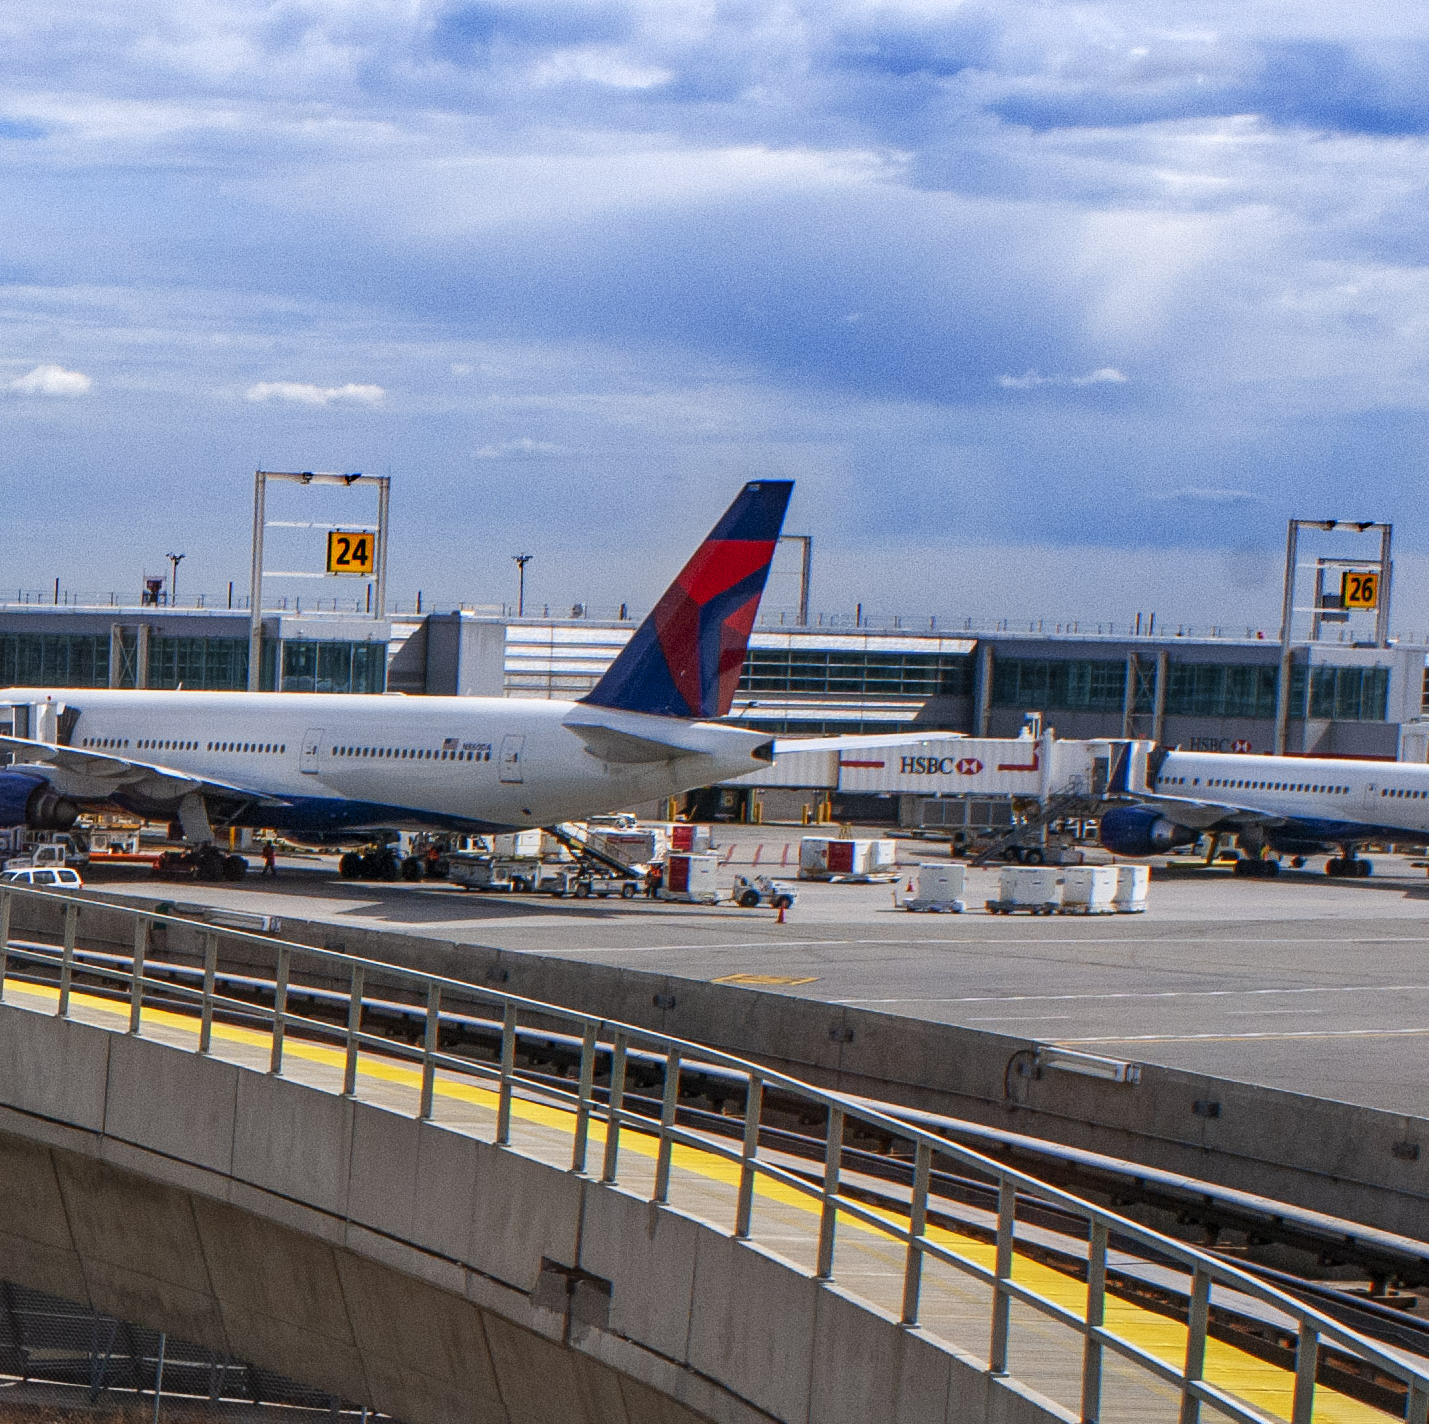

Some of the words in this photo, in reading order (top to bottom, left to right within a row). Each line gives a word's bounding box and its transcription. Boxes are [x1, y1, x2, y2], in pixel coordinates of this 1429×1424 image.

[336, 537, 368, 567] 24
[1348, 577, 1374, 603] 26
[899, 756, 954, 776] HSBC
